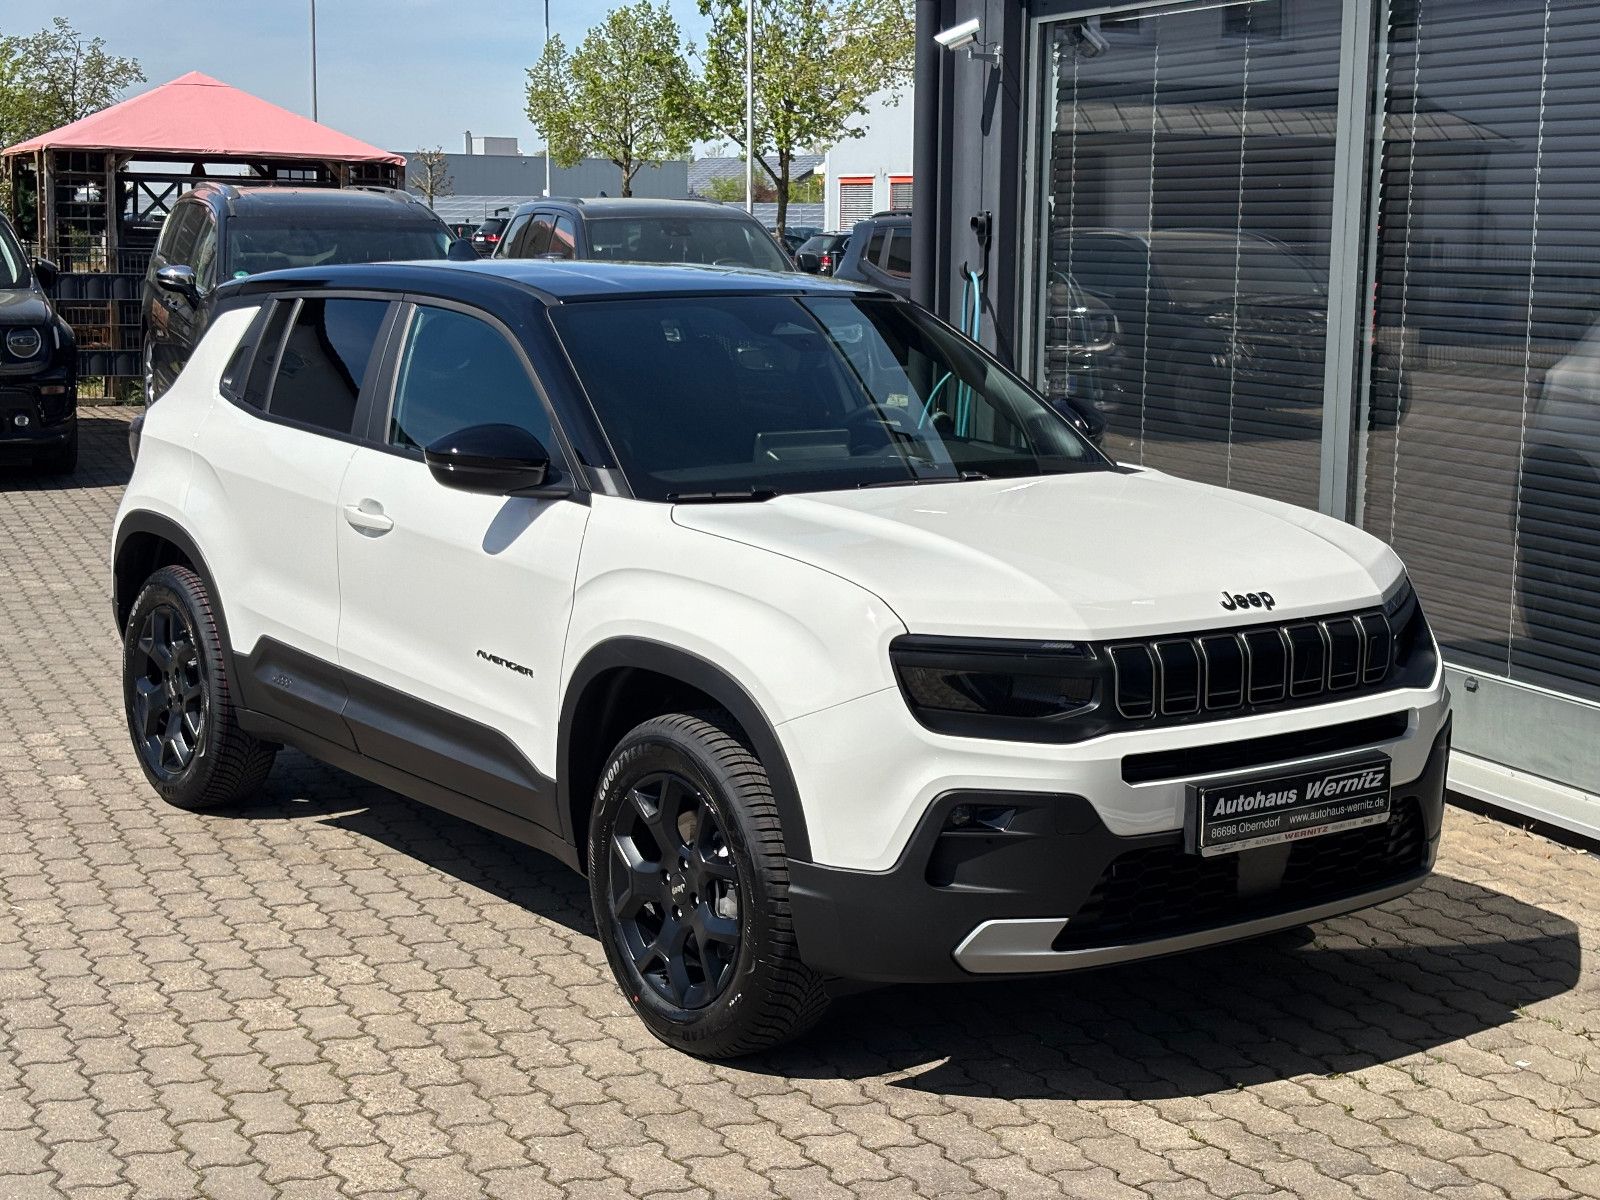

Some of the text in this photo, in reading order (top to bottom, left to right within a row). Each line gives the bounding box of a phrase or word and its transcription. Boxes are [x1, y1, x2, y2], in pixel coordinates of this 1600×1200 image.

[1219, 591, 1276, 611] Jeep
[476, 649, 534, 678] AVENGER
[1213, 770, 1385, 817] Autohaus Wernitz
[1211, 825, 1237, 839] 86698
[1239, 816, 1281, 833] Oberndorf
[1289, 797, 1384, 824] www.autohaus-wernitz.de
[1284, 825, 1329, 840] WERNITZ
